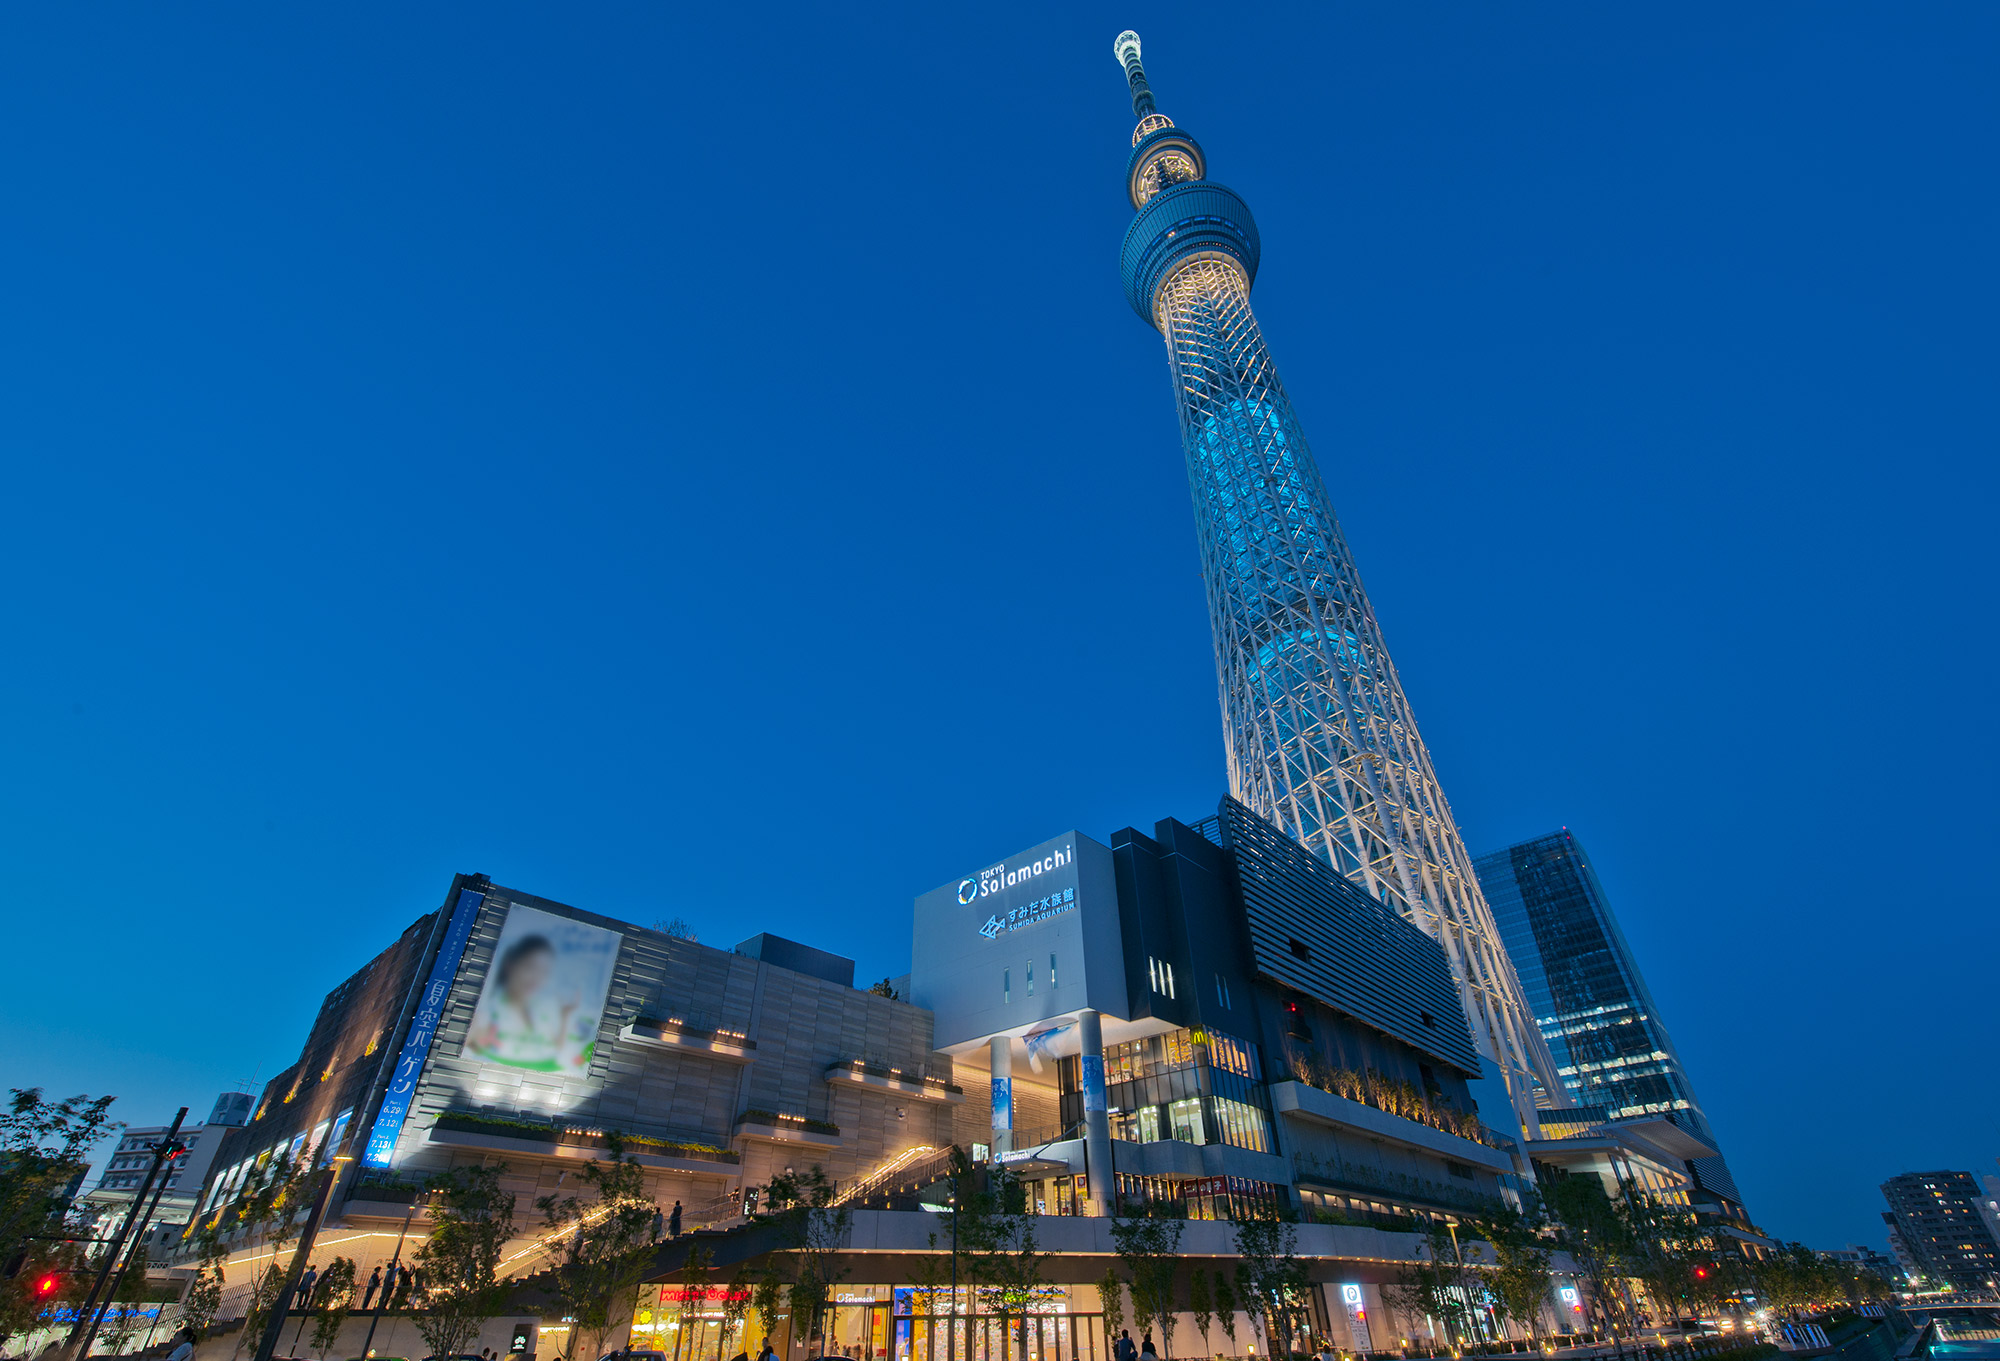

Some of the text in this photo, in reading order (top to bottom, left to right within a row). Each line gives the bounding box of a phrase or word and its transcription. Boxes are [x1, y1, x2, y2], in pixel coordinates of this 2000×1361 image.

[981, 845, 1072, 897] Solamachi
[981, 864, 1005, 880] TOKYO
[1008, 887, 1075, 923] すみだ水族館
[1008, 903, 1076, 932] SUMIDA AQUARIUM
[393, 978, 449, 1094] 夏空バーゲン
[378, 1118, 396, 1127] 7.12
[383, 1106, 401, 1114] 6.29
